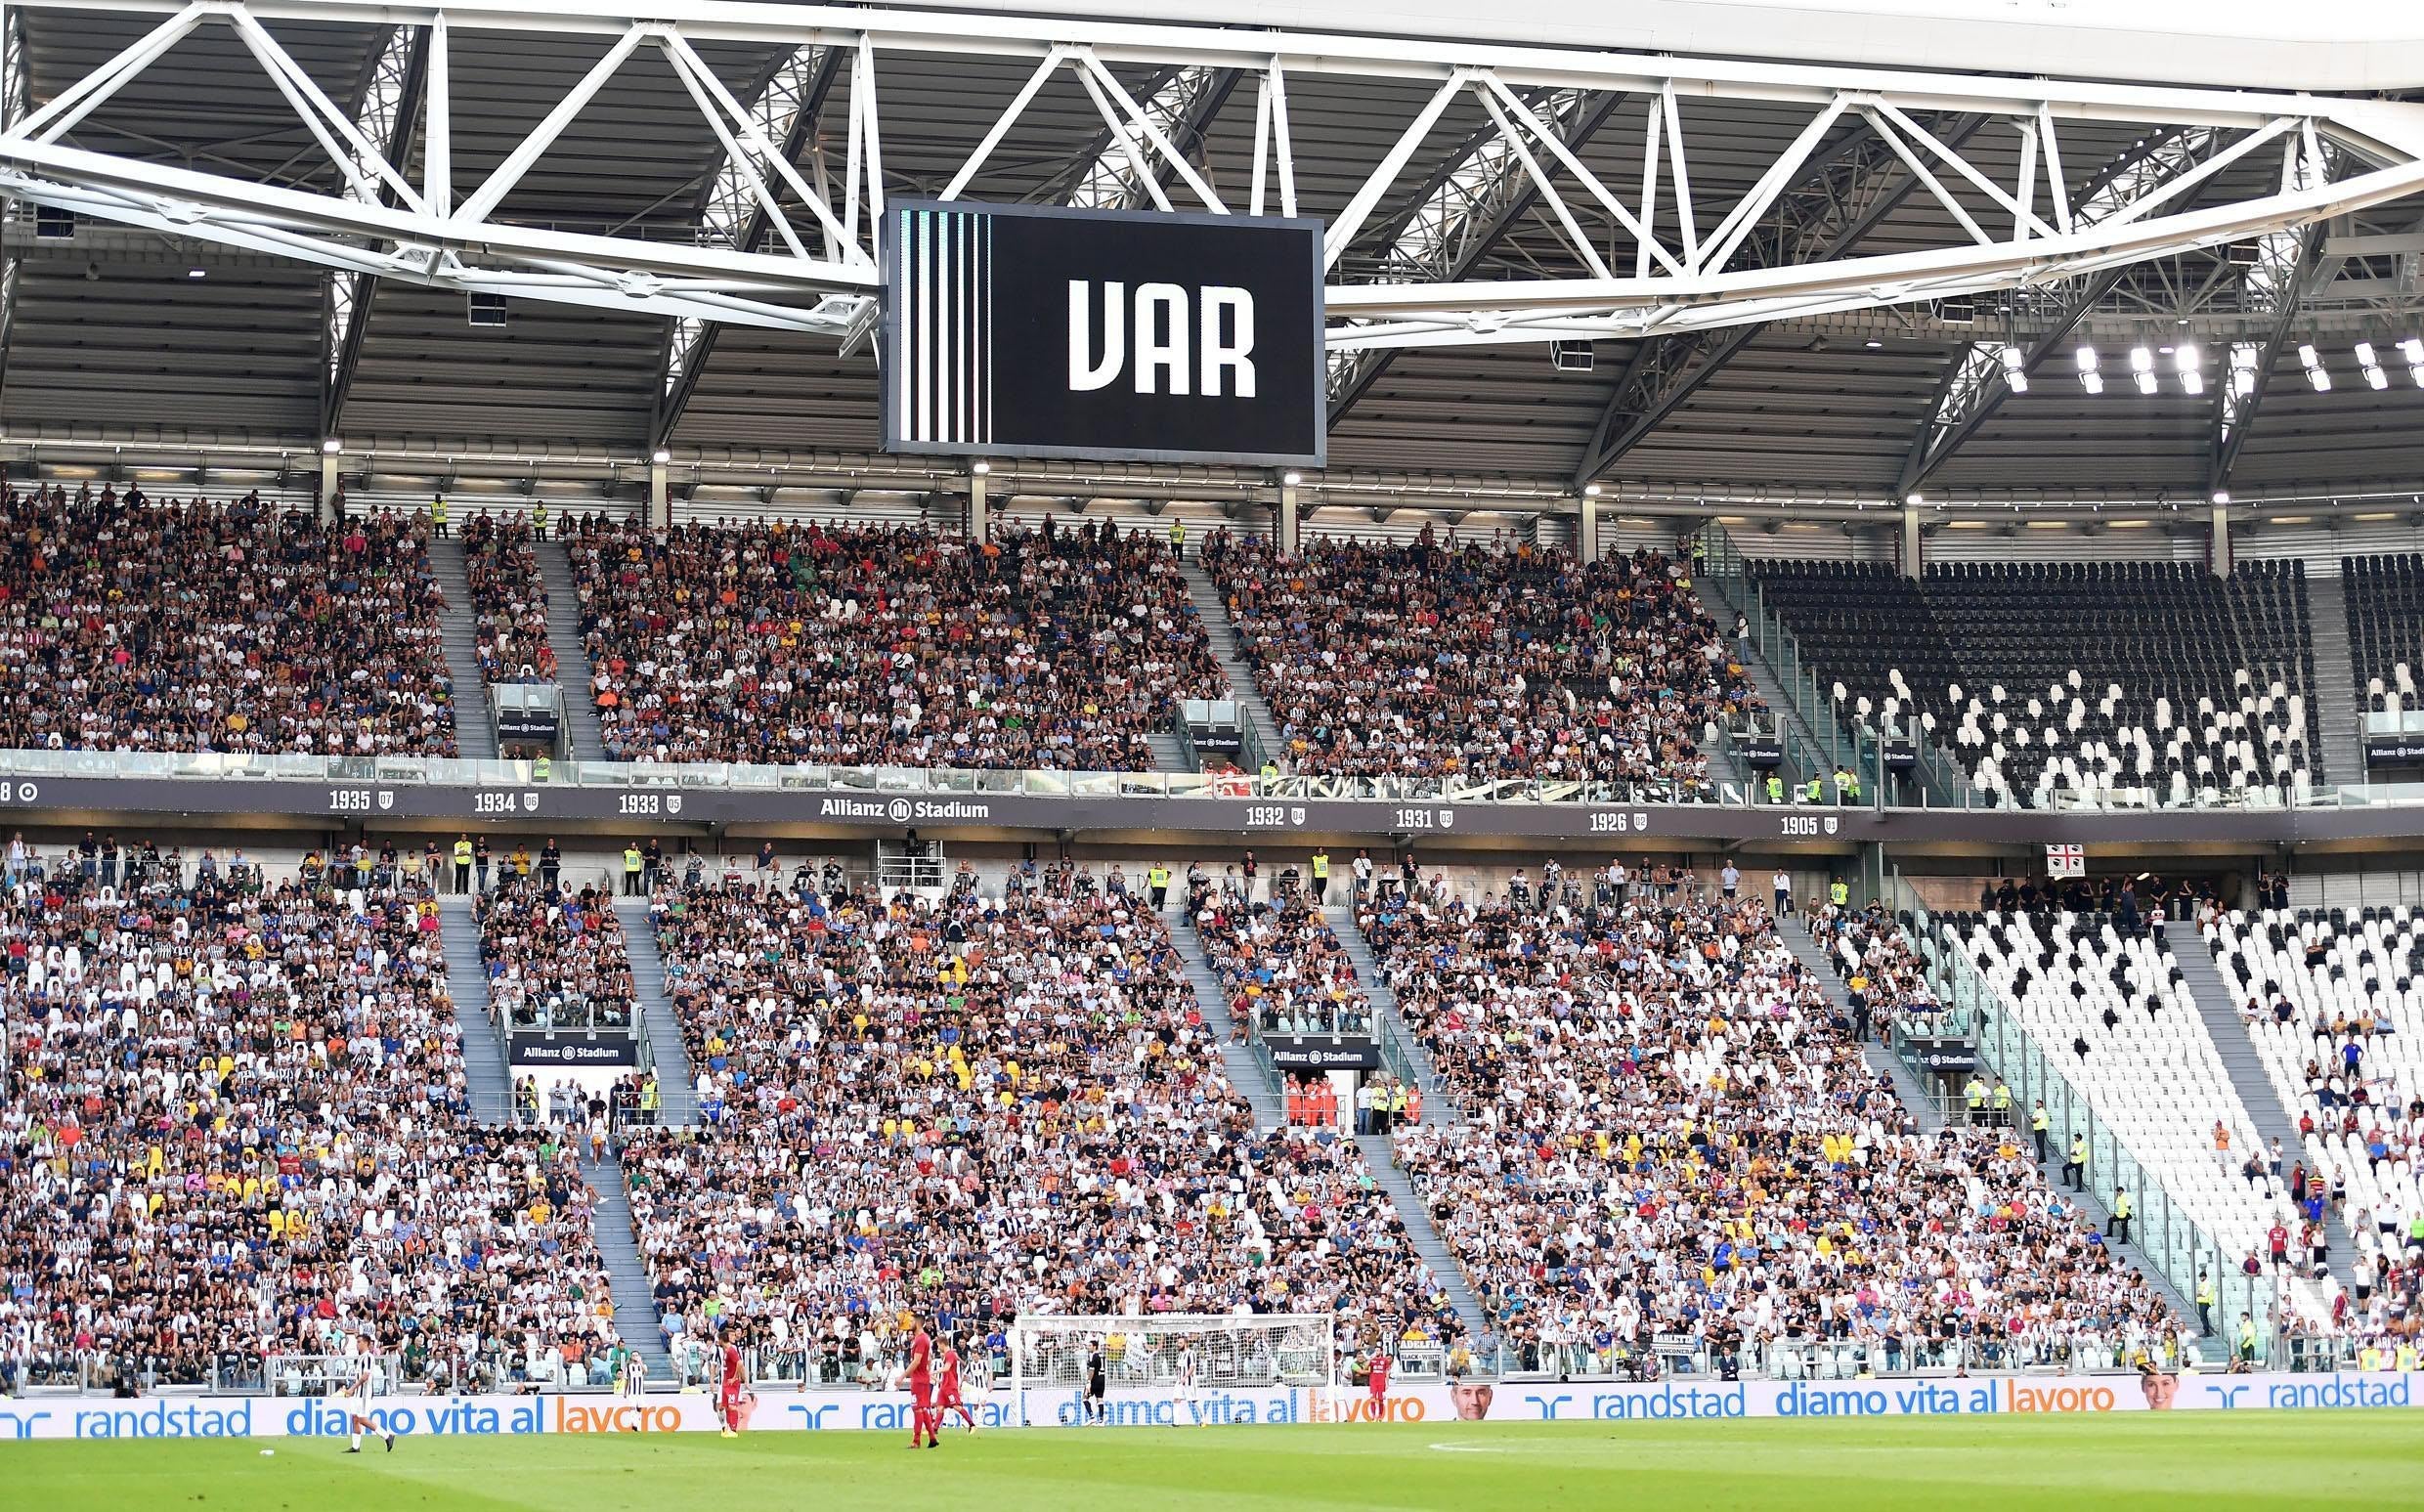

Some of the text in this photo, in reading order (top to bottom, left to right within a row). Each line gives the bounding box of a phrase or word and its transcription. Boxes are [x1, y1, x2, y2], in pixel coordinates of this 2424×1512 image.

[1068, 280, 1256, 398] VAR
[329, 790, 391, 810] 1935 07
[474, 793, 537, 813] 1934 06
[619, 795, 679, 814] 1933 05
[820, 798, 989, 819] Allianz Stadium
[1246, 806, 1303, 826] 1932 04
[1396, 809, 1450, 829] 1931 03
[1590, 812, 1645, 832] 1926 02
[1781, 816, 1836, 836] 1905 01
[523, 1047, 620, 1058] Allianz Stadium
[1274, 1051, 1363, 1062] Allianz Stadium
[1941, 1055, 1974, 1064] Stadium
[1593, 1378, 2114, 1419] randstad diamo vita al lavoro
[2269, 1373, 2410, 1409] randstad
[1188, 1390, 1257, 1425] vita
[1266, 1388, 1298, 1424] al
[75, 1397, 251, 1439] randstad
[425, 1397, 500, 1436] vita
[510, 1396, 544, 1436] al
[557, 1396, 681, 1434] lavoro
